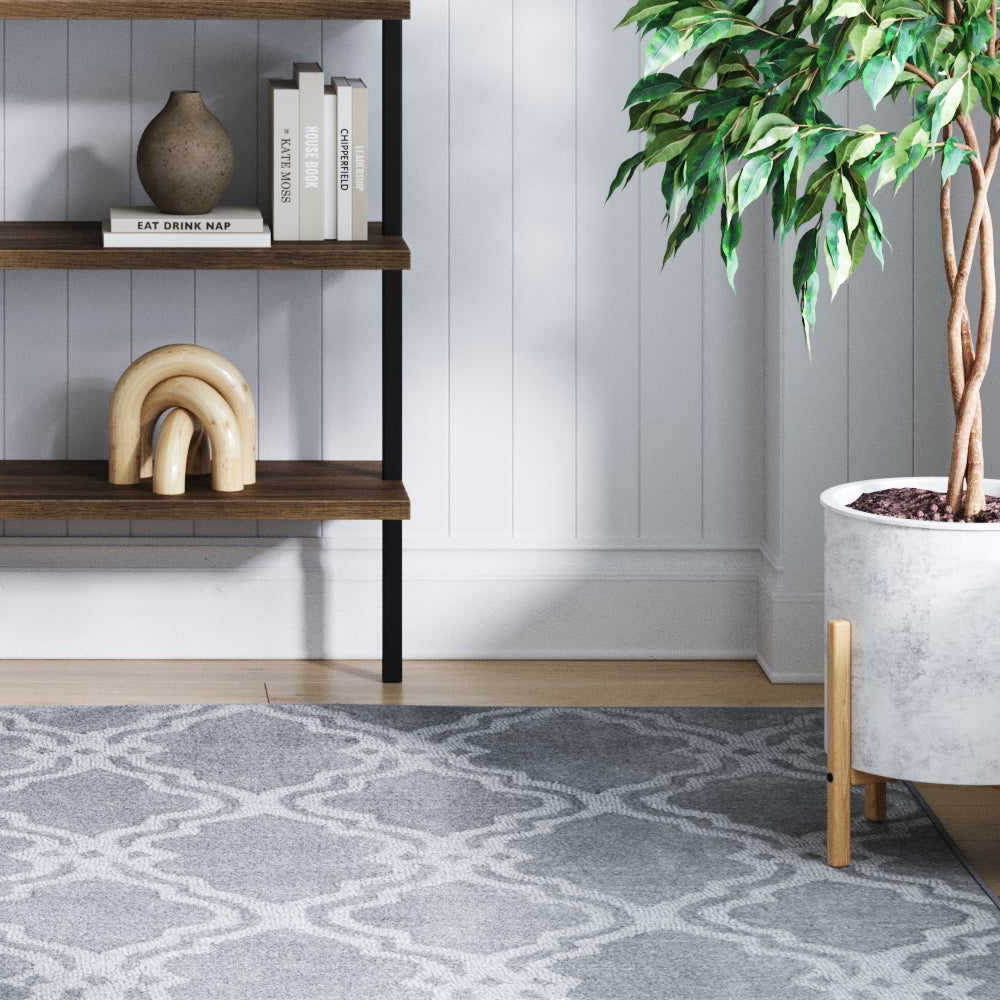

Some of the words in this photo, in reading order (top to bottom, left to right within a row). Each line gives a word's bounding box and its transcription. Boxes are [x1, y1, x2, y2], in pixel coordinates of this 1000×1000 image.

[281, 138, 291, 169] KATE
[304, 126, 319, 159] HOUSE
[304, 161, 319, 189] BOOK
[340, 128, 349, 191] CHIPPERFIELD
[355, 145, 365, 192] LEADERSHIP
[281, 172, 291, 204] MOSS
[137, 221, 160, 230] EAT
[164, 221, 202, 230] DRINK
[206, 221, 231, 230] NAP
